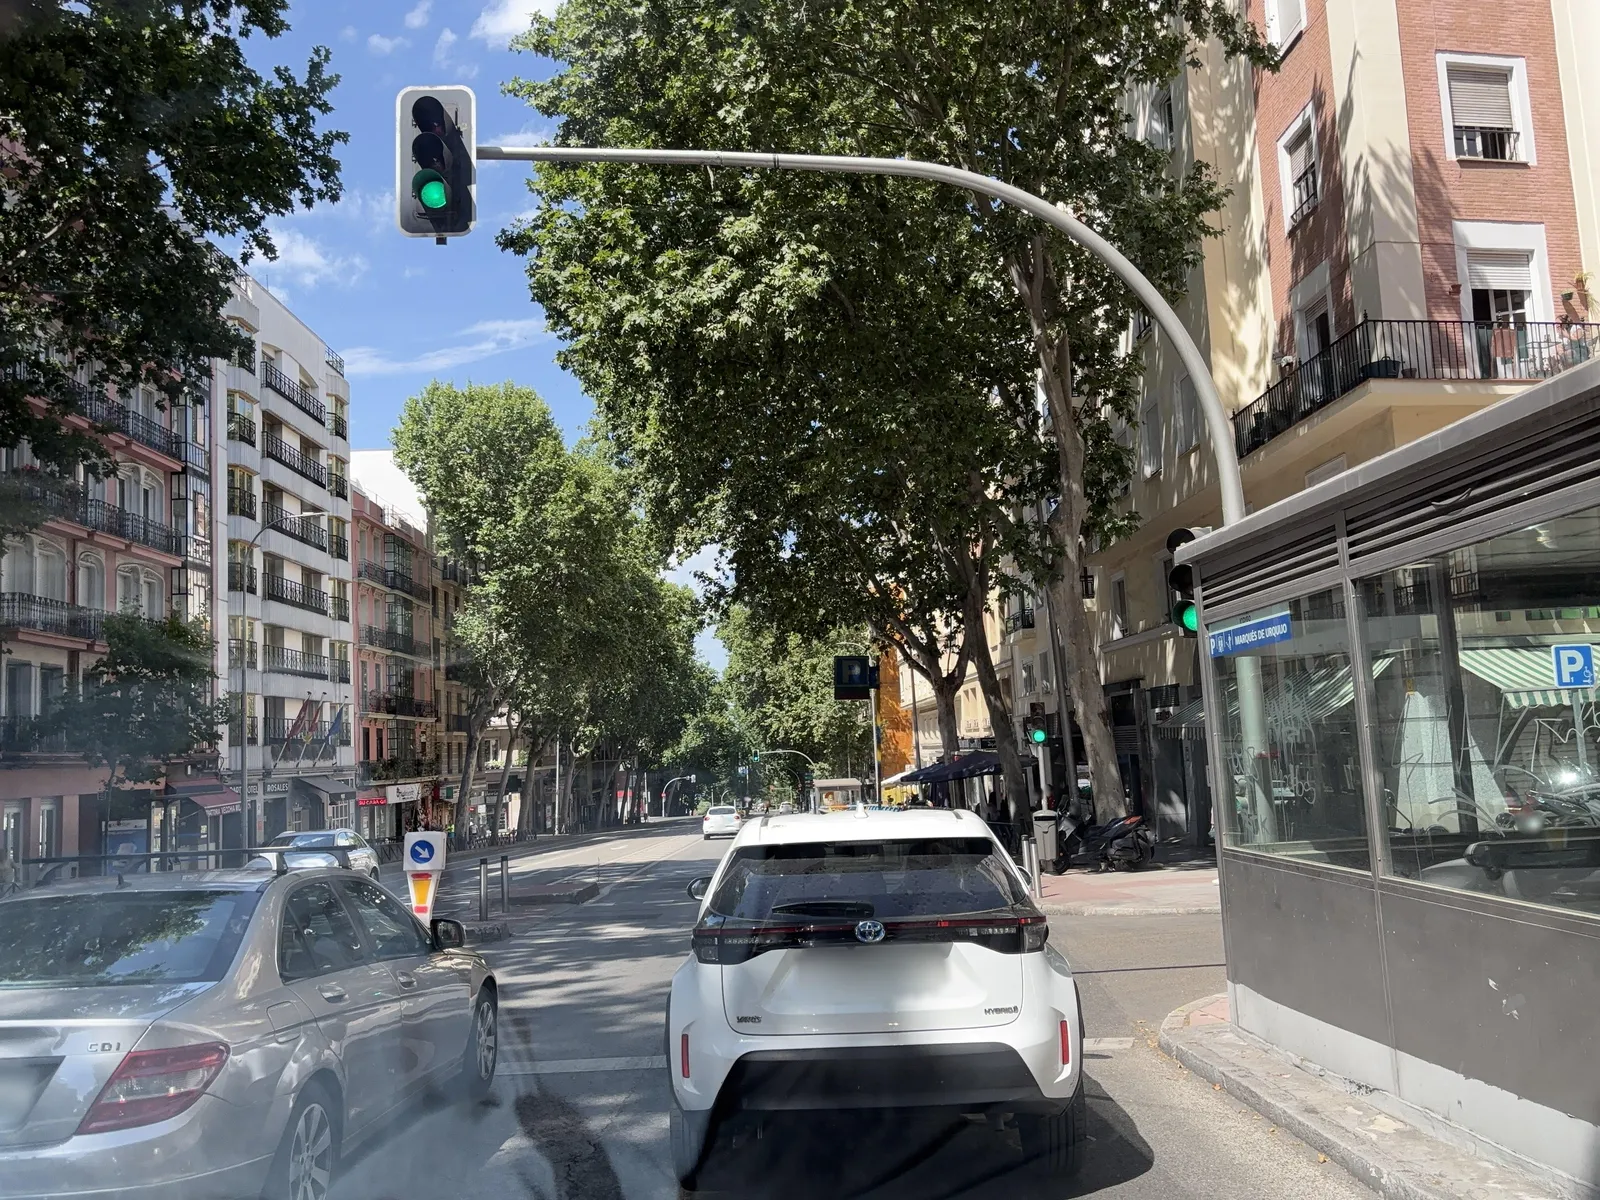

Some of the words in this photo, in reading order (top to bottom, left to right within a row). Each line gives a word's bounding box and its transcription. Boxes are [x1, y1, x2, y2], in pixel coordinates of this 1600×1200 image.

[1234, 630, 1258, 645] MARQUÉS
[1258, 629, 1265, 640] DE
[1265, 623, 1288, 638] URQUIJO
[1559, 650, 1584, 683] P
[266, 783, 289, 792] ROSALES
[984, 1006, 1014, 1015] HYBRID
[87, 1042, 121, 1052] CDI
